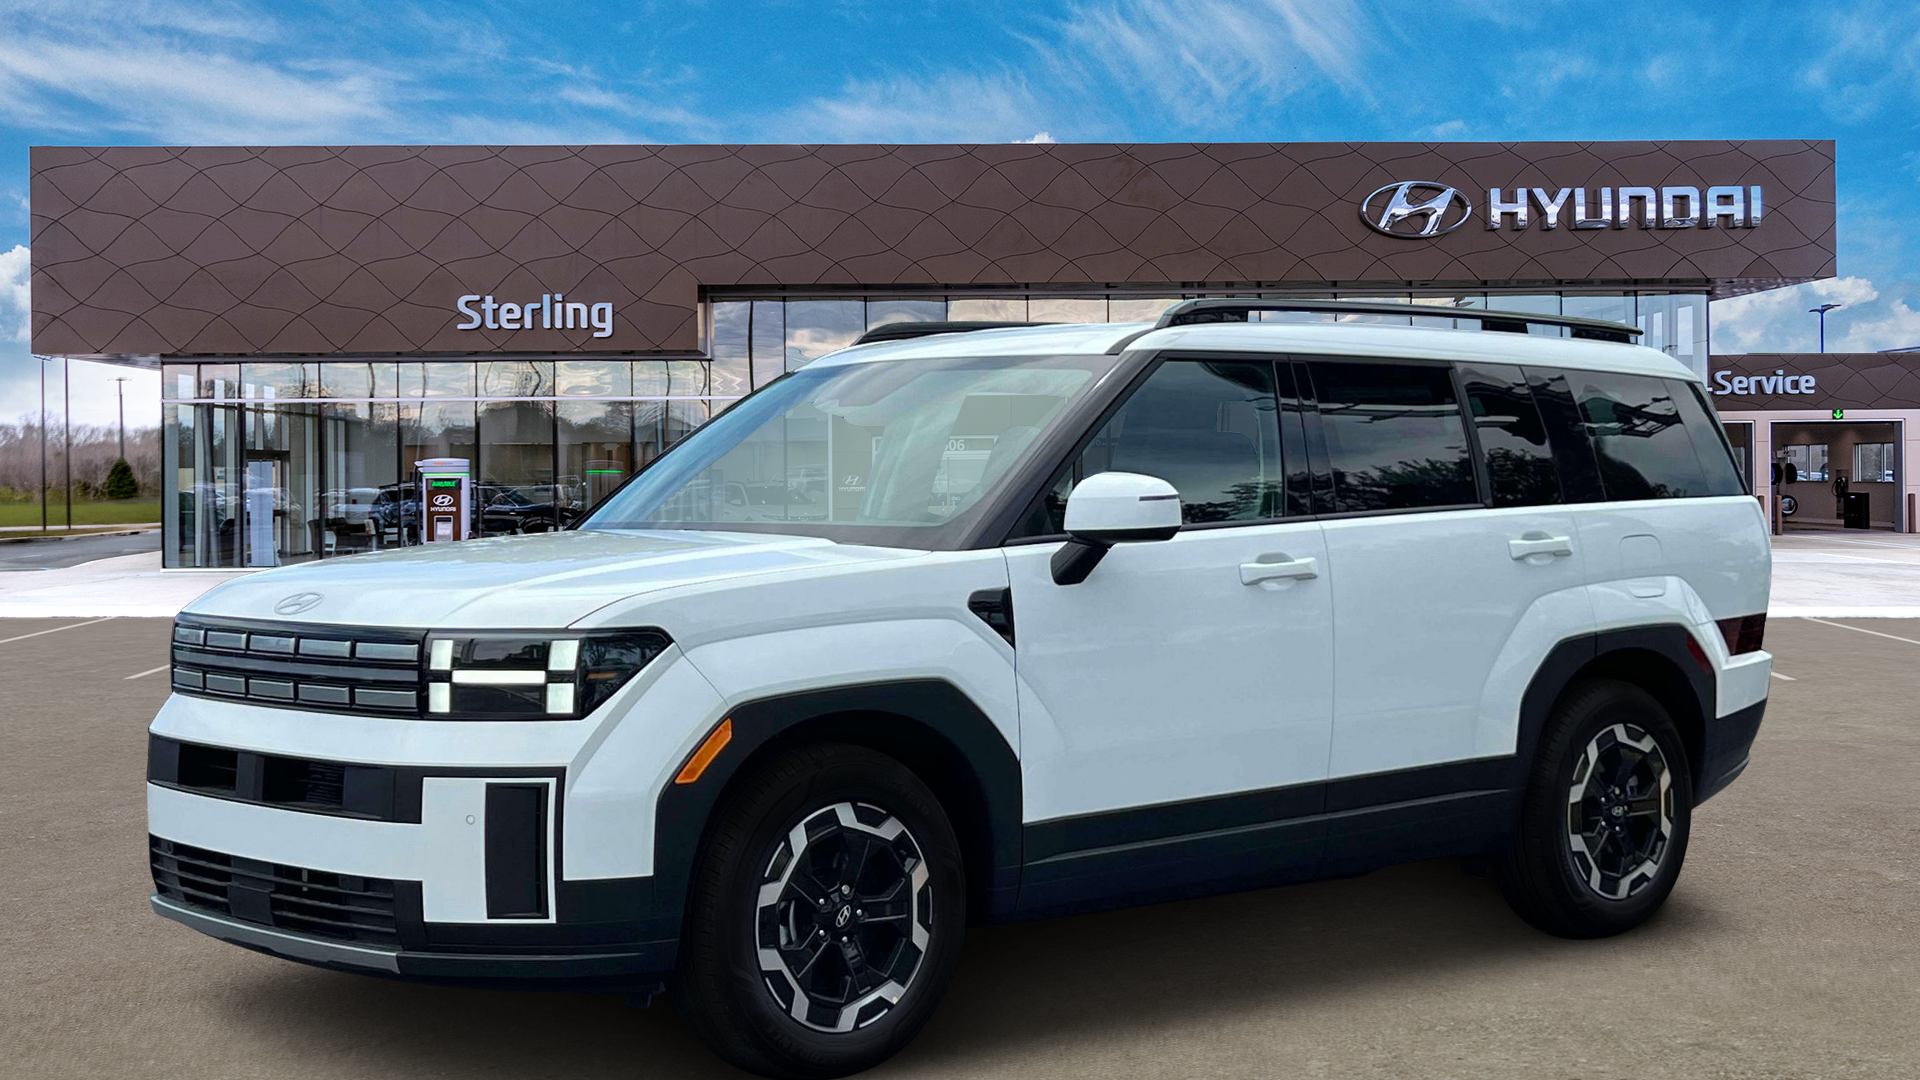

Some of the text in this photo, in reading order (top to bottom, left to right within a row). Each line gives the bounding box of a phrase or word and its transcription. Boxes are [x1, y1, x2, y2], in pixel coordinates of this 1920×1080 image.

[1487, 185, 1762, 229] HYUNDAI
[457, 293, 613, 338] Sterling
[1714, 369, 1816, 395] Service
[945, 439, 965, 451] 06
